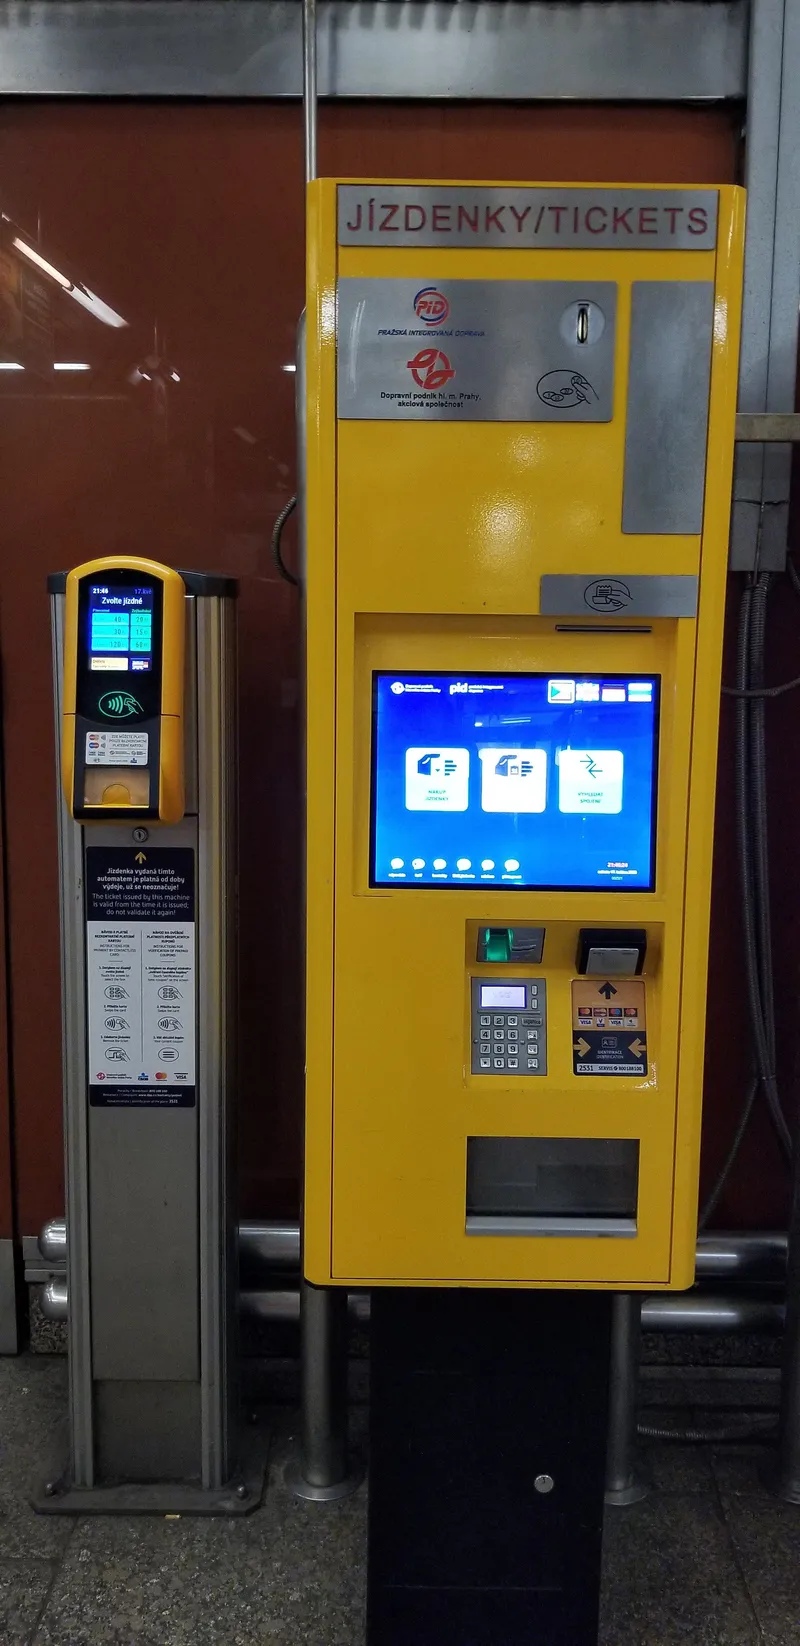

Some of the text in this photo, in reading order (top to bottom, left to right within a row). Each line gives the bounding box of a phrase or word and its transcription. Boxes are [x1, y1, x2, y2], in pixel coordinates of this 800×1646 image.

[346, 198, 708, 236] JÍZDENKY/TICKETS
[377, 328, 408, 336] PRAŽSKÁ
[380, 391, 412, 399] Dopravní
[413, 392, 437, 400] podnik
[123, 597, 143, 605] jízdné
[157, 909, 176, 917] again!
